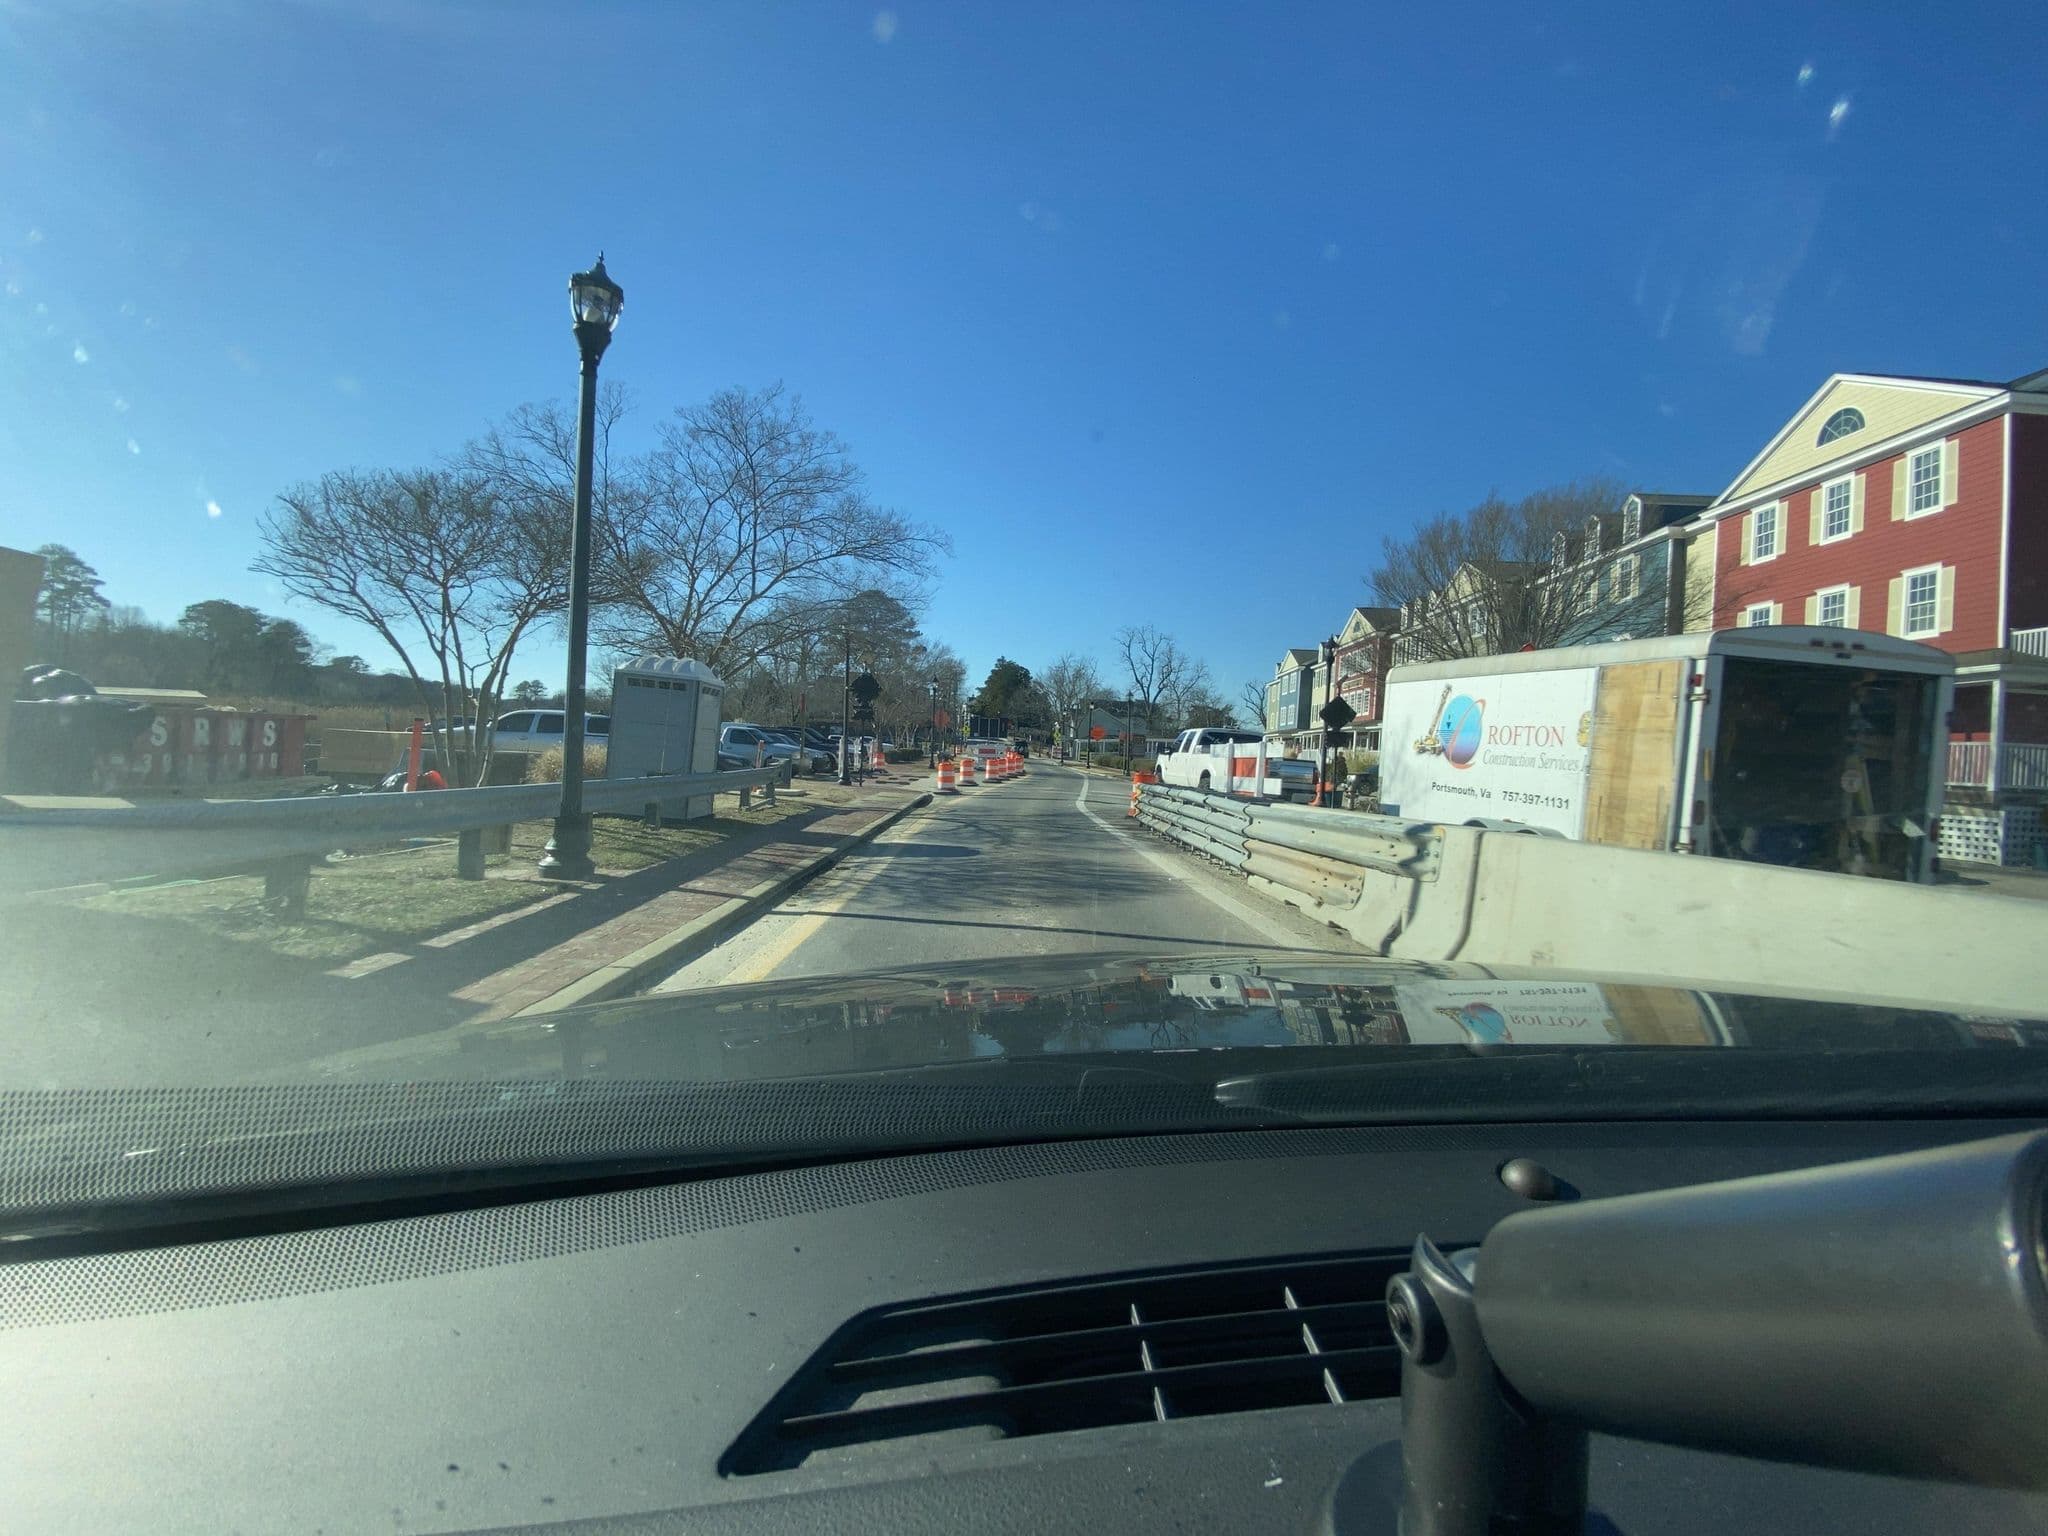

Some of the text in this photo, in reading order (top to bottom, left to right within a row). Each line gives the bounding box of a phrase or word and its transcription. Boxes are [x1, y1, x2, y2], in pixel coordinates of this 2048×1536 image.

[1482, 749, 1536, 768] Construction
[1538, 752, 1580, 772] Services
[1431, 781, 1570, 810] Portsmouth, Va 757-397-1131
